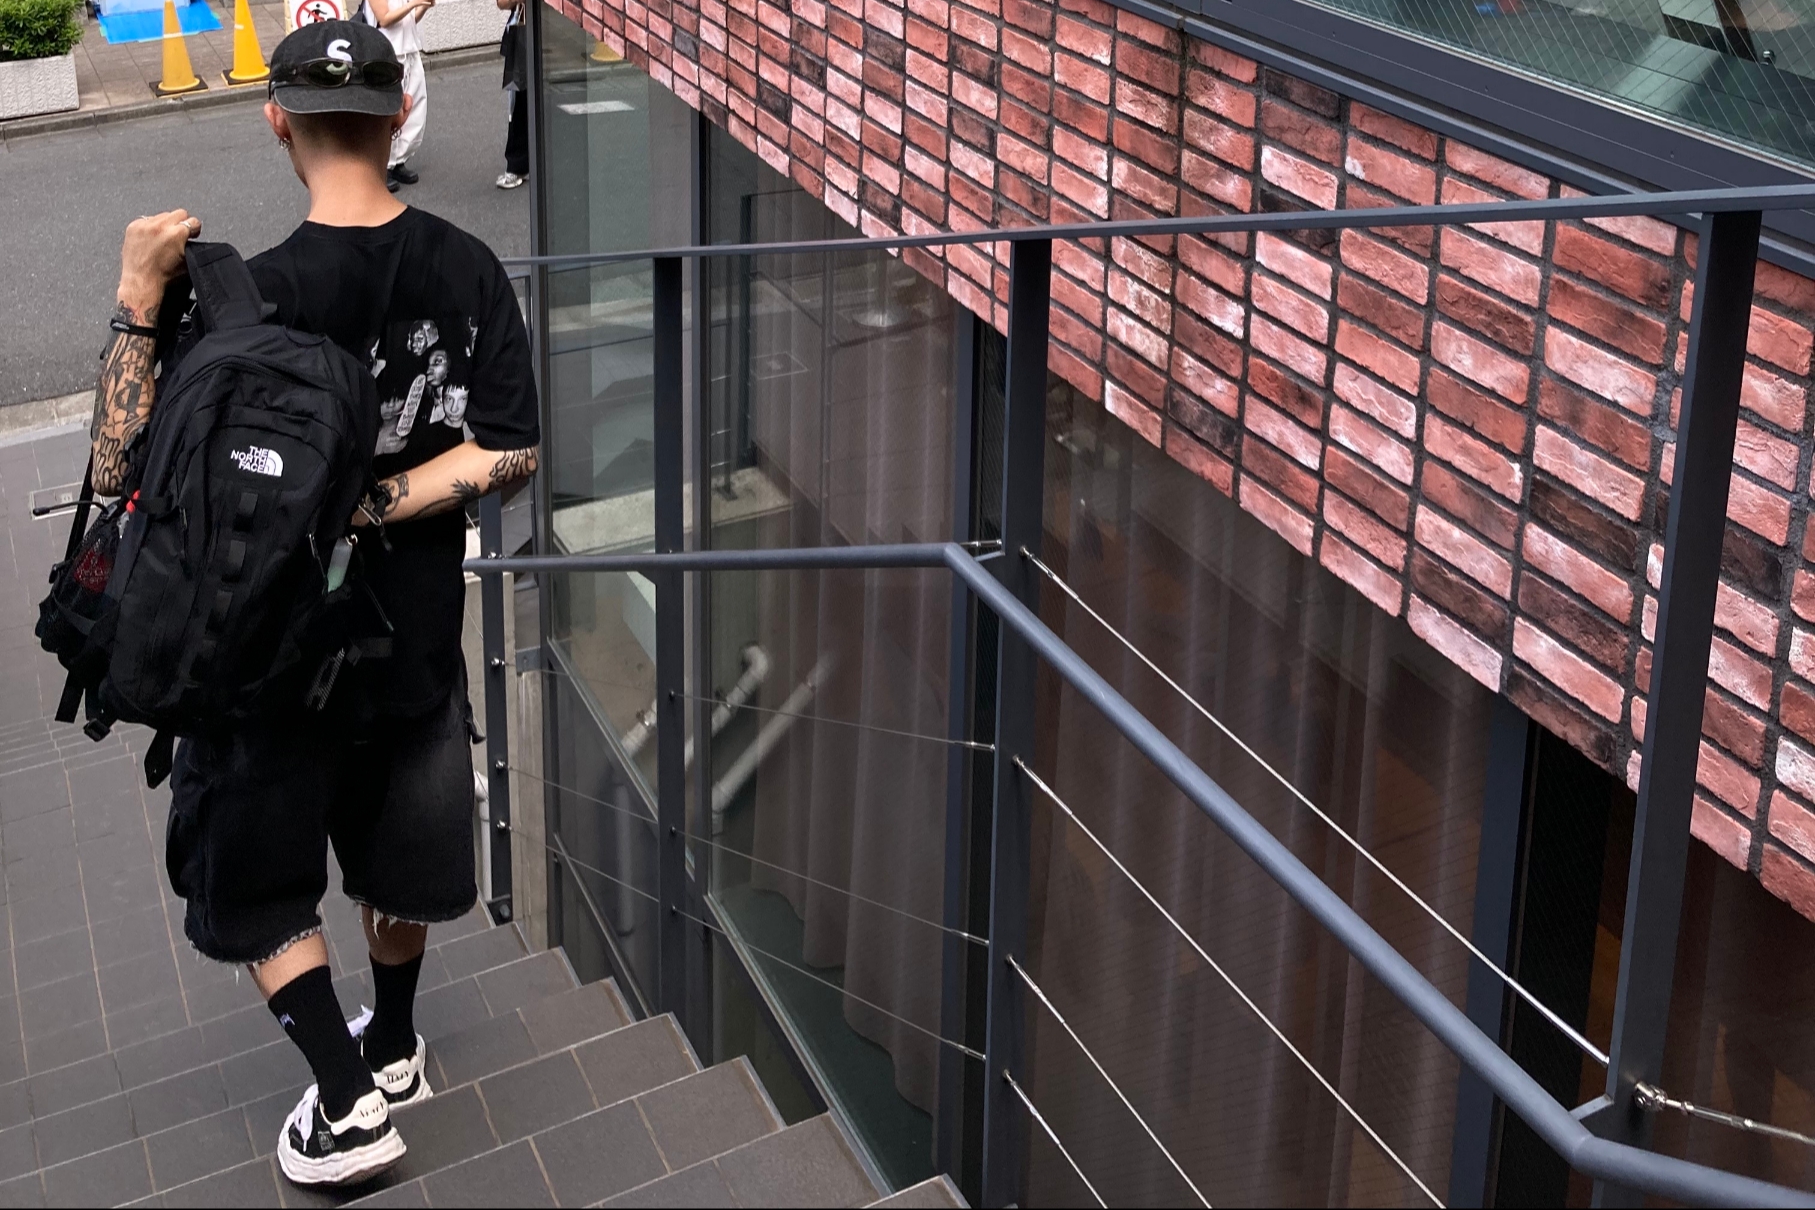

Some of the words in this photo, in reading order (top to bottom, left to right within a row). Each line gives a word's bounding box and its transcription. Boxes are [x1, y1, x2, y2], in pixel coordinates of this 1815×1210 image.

[326, 38, 353, 76] S
[230, 449, 267, 466] NORTH
[249, 445, 268, 457] THE
[238, 461, 265, 473] FACE
